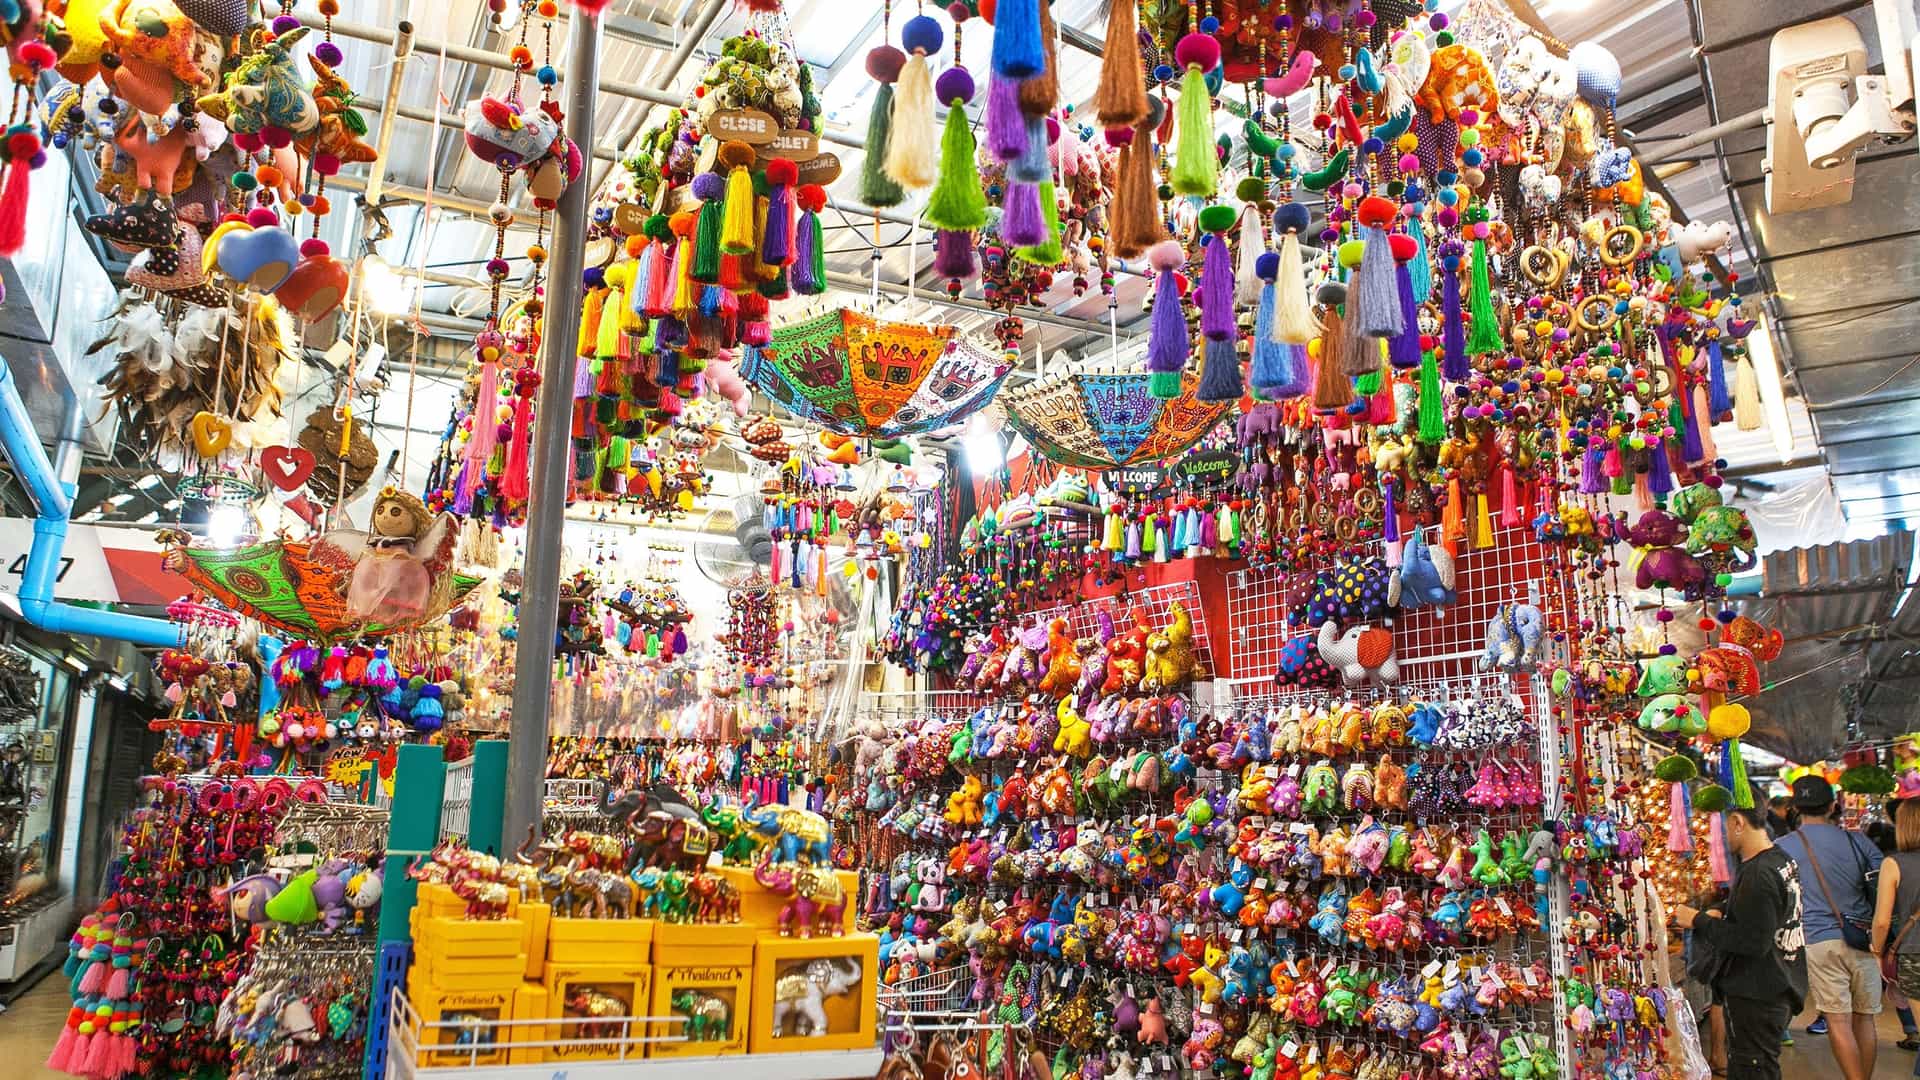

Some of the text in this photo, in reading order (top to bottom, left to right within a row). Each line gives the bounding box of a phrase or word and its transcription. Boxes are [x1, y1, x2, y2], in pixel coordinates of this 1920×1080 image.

[719, 116, 767, 134] CLOSE
[766, 136, 810, 150] OILET
[1181, 460, 1232, 474] Welcome
[677, 967, 734, 981] Thailand
